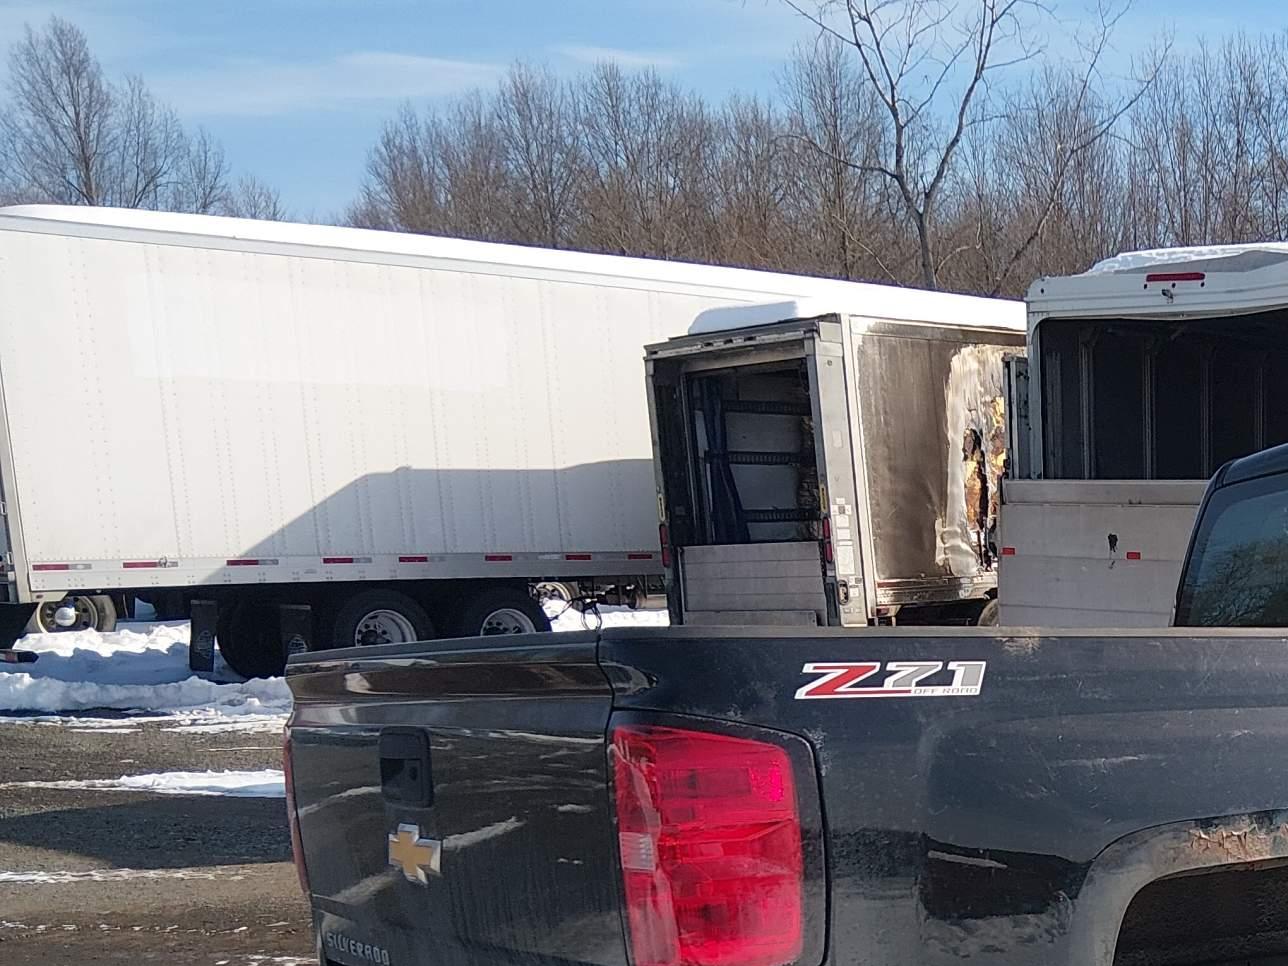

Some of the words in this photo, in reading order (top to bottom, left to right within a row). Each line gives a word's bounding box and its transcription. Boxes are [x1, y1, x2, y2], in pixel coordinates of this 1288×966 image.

[795, 661, 986, 699] Z71
[914, 687, 938, 695] OFF
[942, 686, 978, 695] ROAD
[326, 932, 390, 966] SILVERADO
